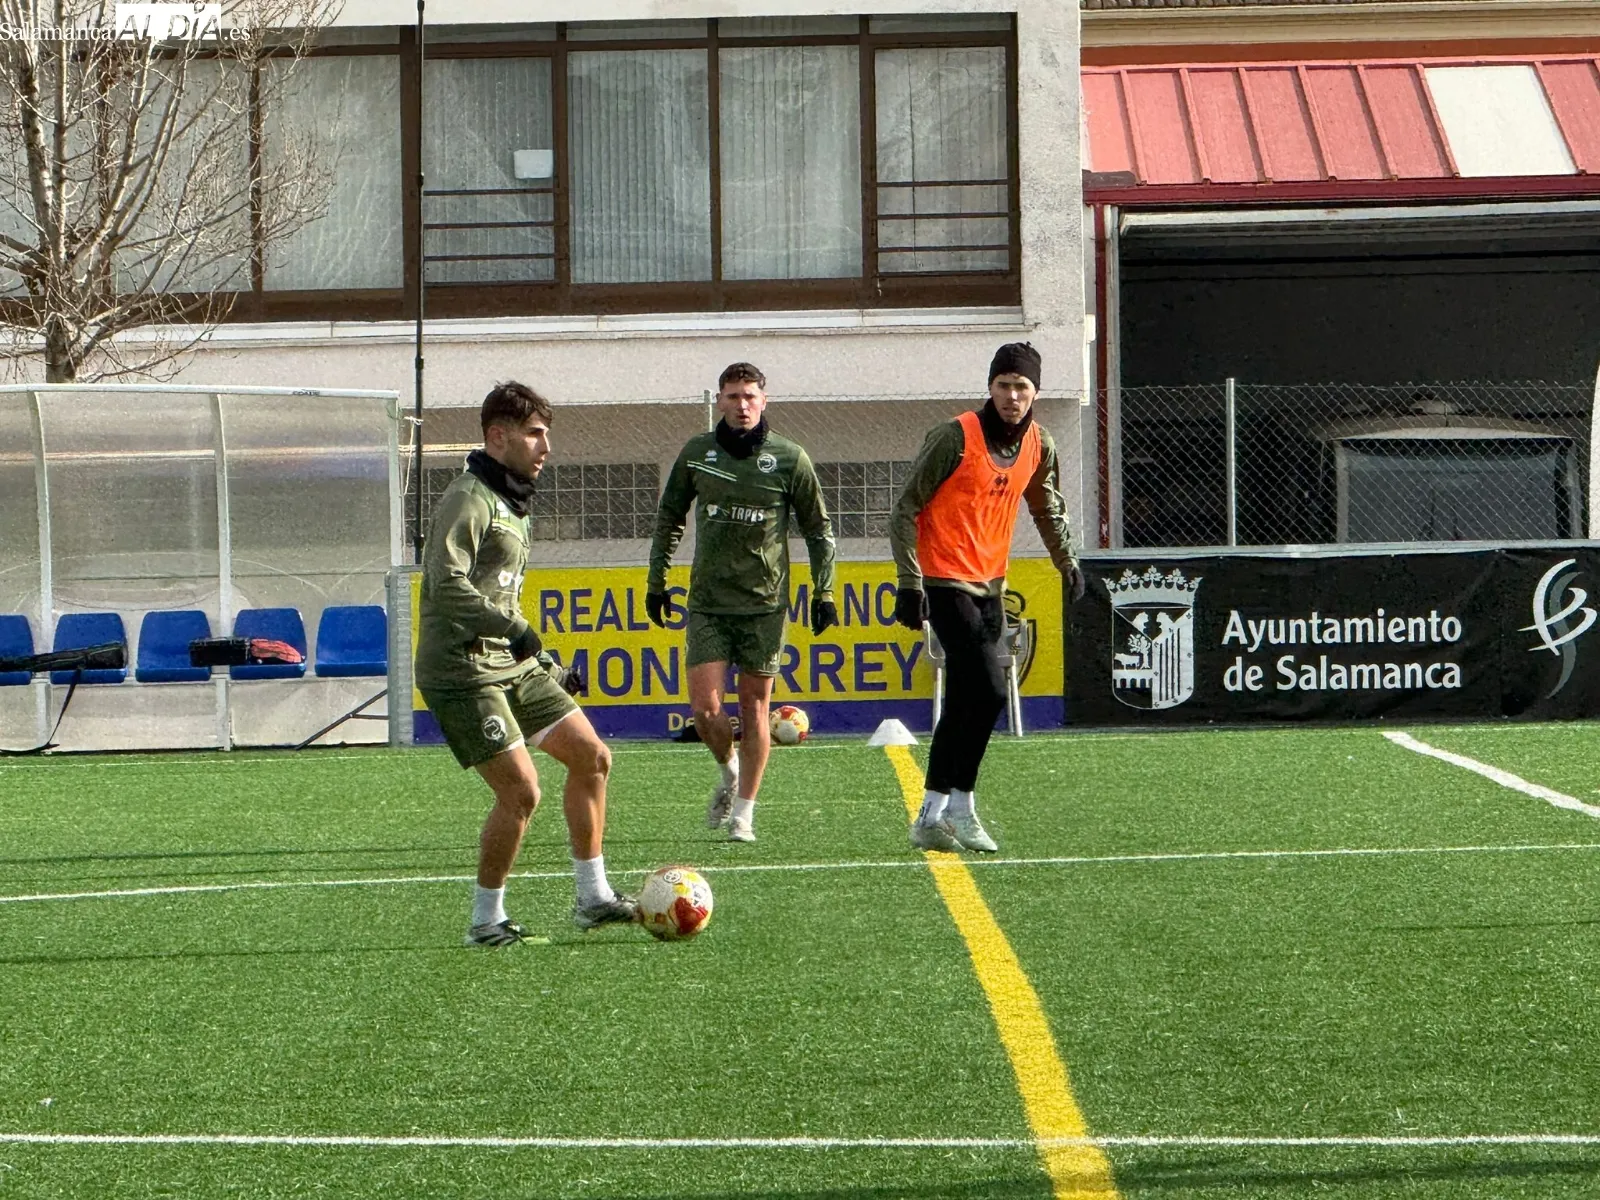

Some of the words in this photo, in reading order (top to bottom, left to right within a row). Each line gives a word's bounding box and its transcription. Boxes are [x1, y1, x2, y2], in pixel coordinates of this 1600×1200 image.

[540, 587, 649, 633] REAL
[1221, 608, 1462, 652] Ayuntamiento
[548, 641, 924, 697] MONRREY
[1223, 656, 1263, 691] de
[1276, 655, 1461, 690] Salamanca
